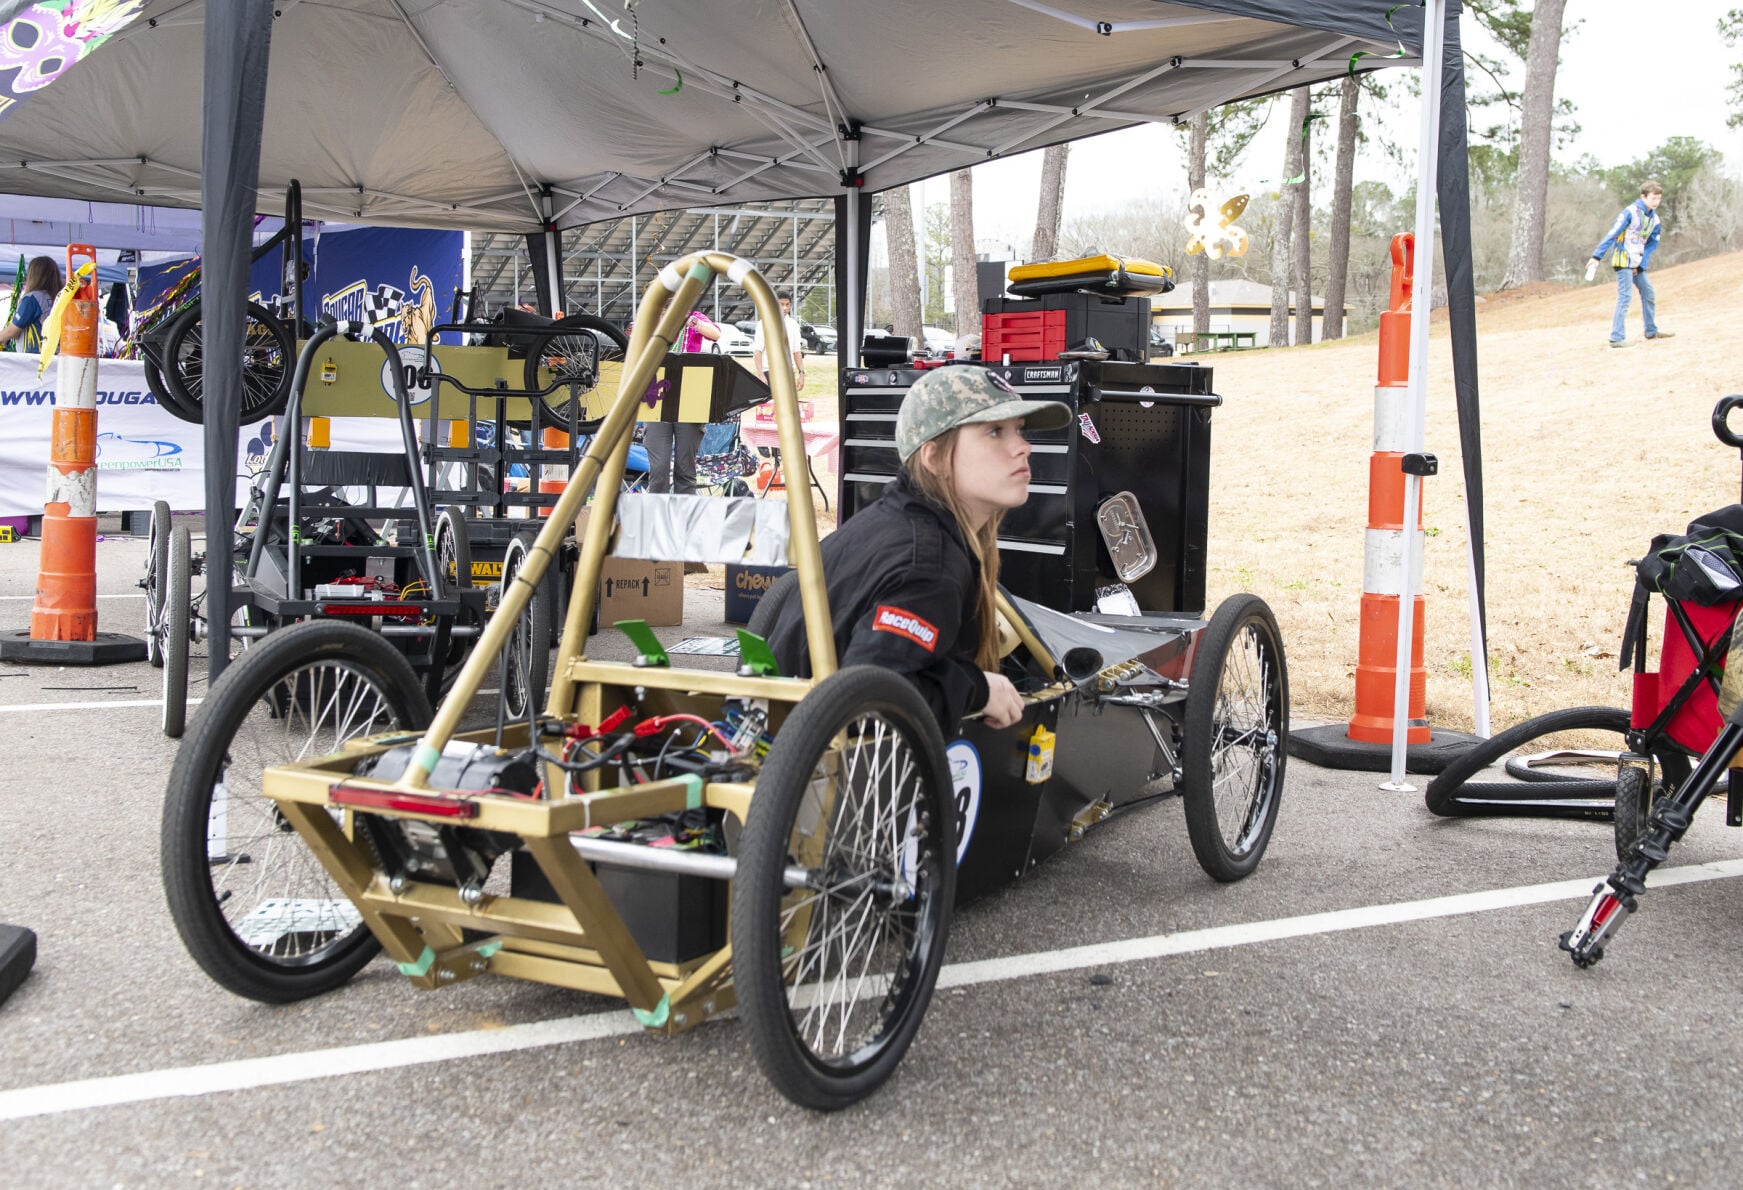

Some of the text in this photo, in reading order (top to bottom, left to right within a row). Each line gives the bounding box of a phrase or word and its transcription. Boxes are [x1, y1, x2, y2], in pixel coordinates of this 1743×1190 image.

[1026, 370, 1059, 379] CRAFTSMAN
[616, 580, 640, 590] REPACK
[879, 611, 935, 643] RaceQuip
